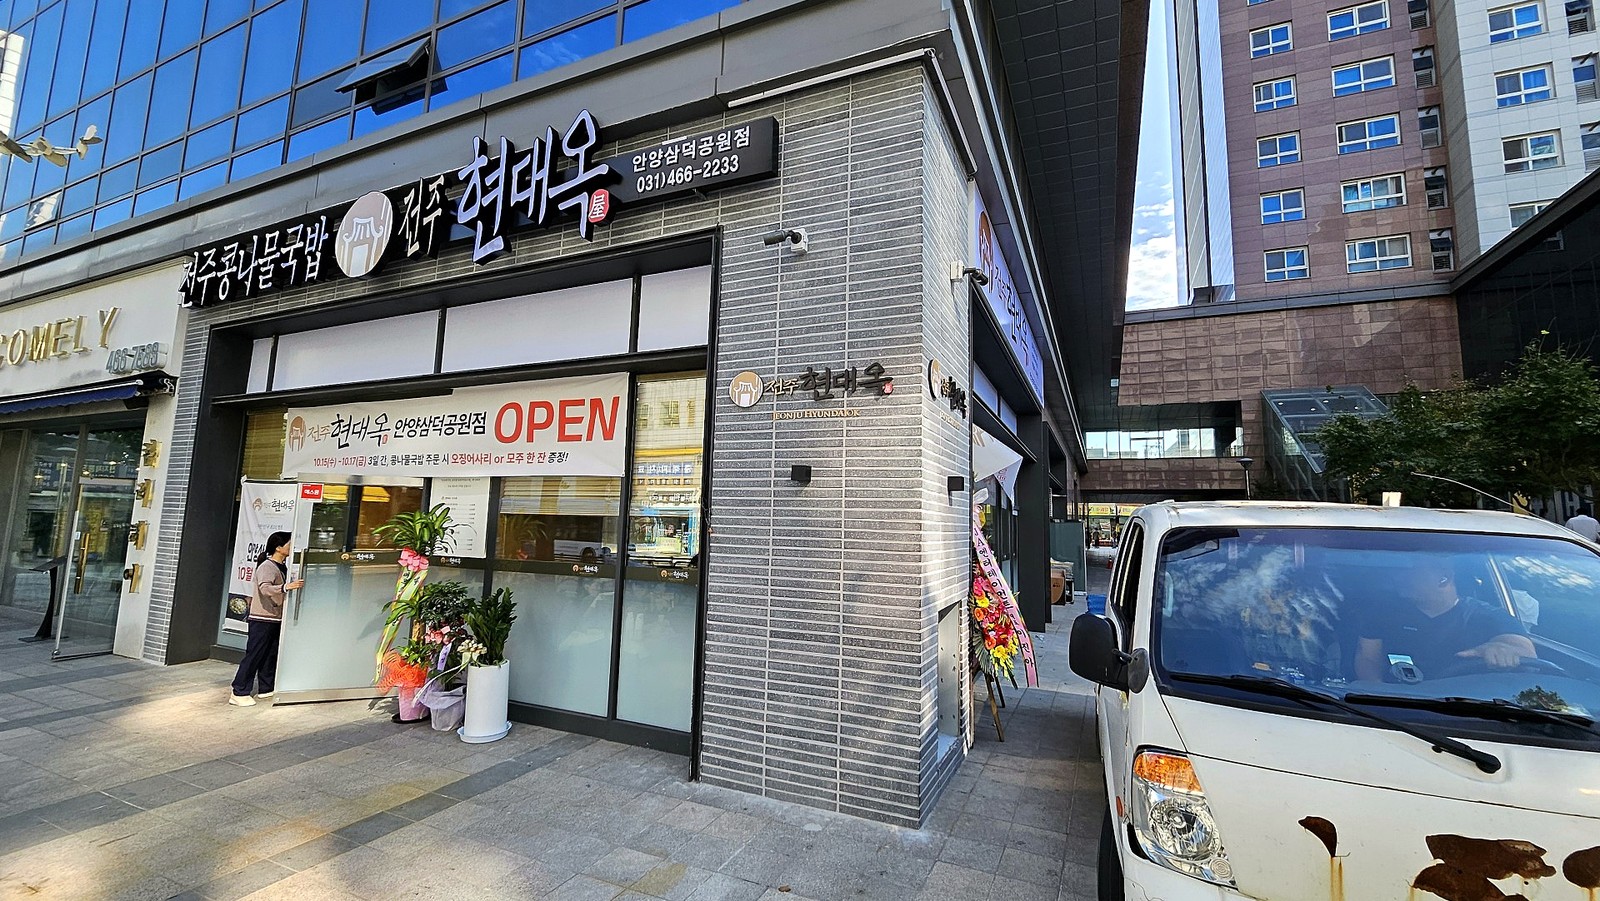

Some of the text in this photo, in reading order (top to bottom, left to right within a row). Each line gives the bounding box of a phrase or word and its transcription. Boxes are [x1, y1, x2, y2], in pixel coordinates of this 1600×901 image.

[632, 126, 750, 173] 안양삼덕공원점
[398, 109, 609, 264] 전주 현대옥
[636, 154, 739, 193] 031)466-2233
[178, 215, 328, 307] 전주콩나물국밥
[764, 377, 799, 396] 전주
[799, 362, 893, 400] 현대옥
[307, 425, 331, 442] 전주
[330, 413, 391, 449] 현대옥
[393, 412, 487, 438] 안양삼덕공원점
[494, 396, 620, 444] OPEN
[313, 457, 337, 468] 10.15(수)
[391, 454, 424, 466] 콩나물국밥
[426, 453, 440, 465] 주문
[442, 453, 449, 465] 시
[451, 453, 492, 465] 오징어사리
[494, 455, 504, 464] or
[506, 452, 524, 464] 모주
[526, 452, 535, 464] 한
[537, 452, 546, 464] 잔
[548, 451, 569, 463] 증정!
